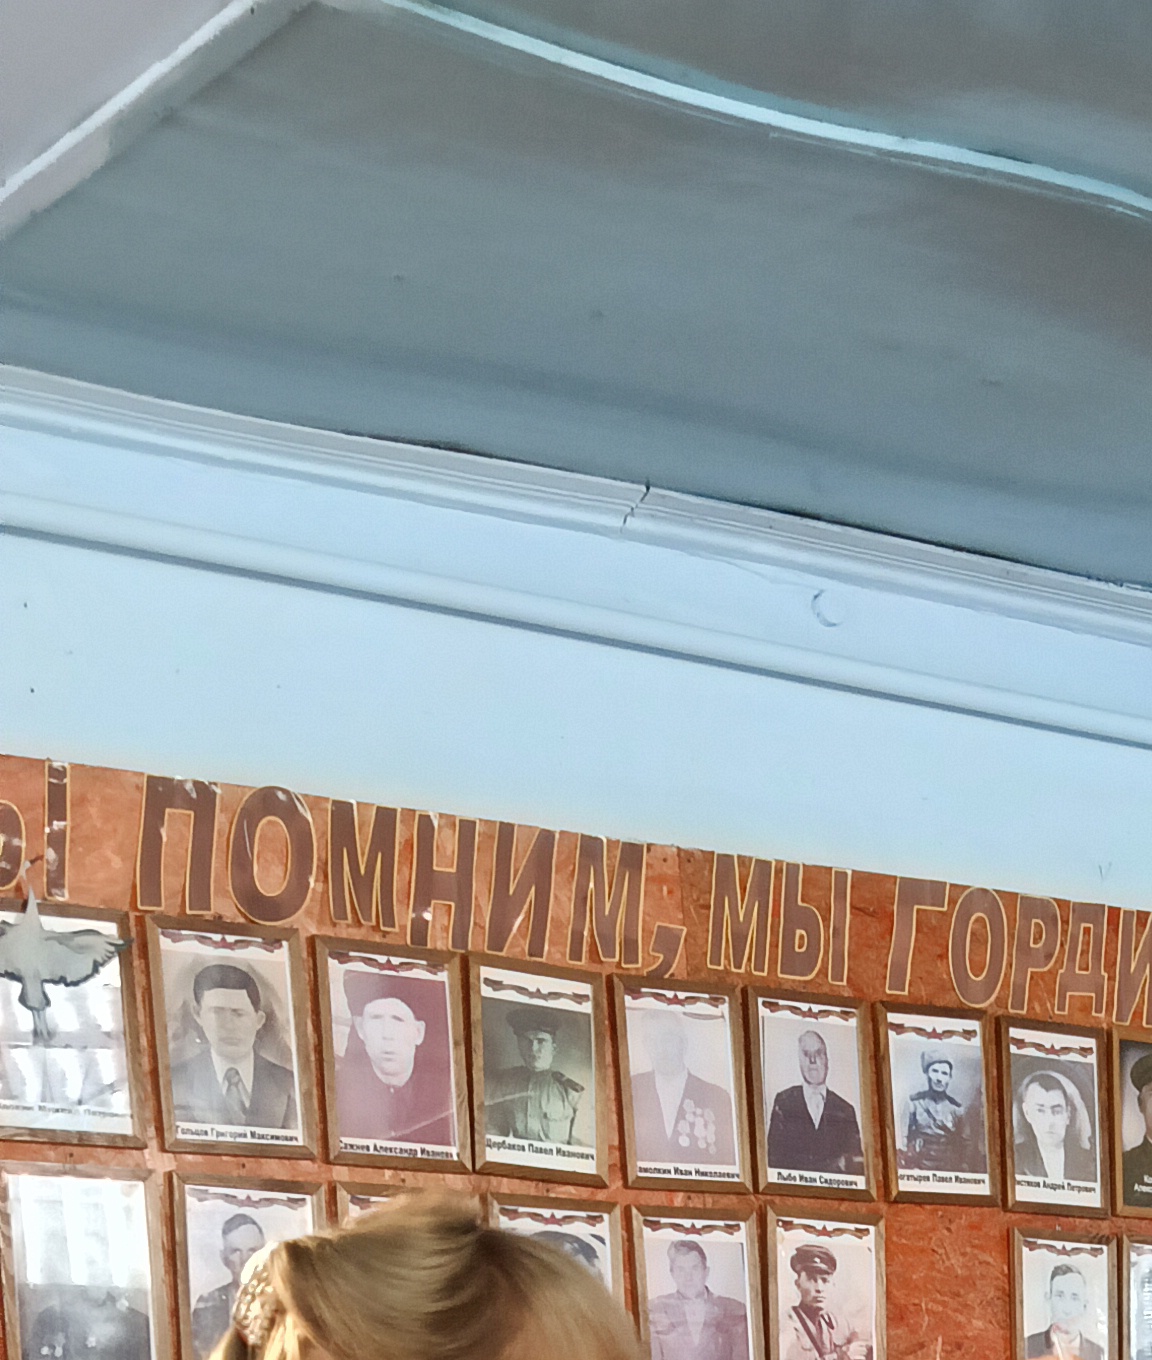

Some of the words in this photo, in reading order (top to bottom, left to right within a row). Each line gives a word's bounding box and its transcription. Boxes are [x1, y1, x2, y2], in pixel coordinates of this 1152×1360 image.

[137, 773, 687, 978] ПОМНИМ,
[707, 850, 852, 985] МЫ
[250, 1129, 300, 1143] Максимович
[373, 1143, 418, 1158] Александр
[528, 1143, 554, 1156] Павел
[556, 1146, 595, 1161] Иванович
[638, 1165, 672, 1176] амолкин
[673, 1166, 693, 1177] Иван
[695, 1168, 741, 1179] Николаевич
[898, 1173, 931, 1185] огатырев
[932, 1173, 953, 1183] Павел
[954, 1175, 986, 1185] Иванович
[799, 1173, 818, 1184] Иван
[819, 1175, 858, 1188] Сидорович
[1015, 1178, 1041, 1189] истяков
[1042, 1179, 1066, 1191] Андрей
[1067, 1181, 1097, 1194] Петрович
